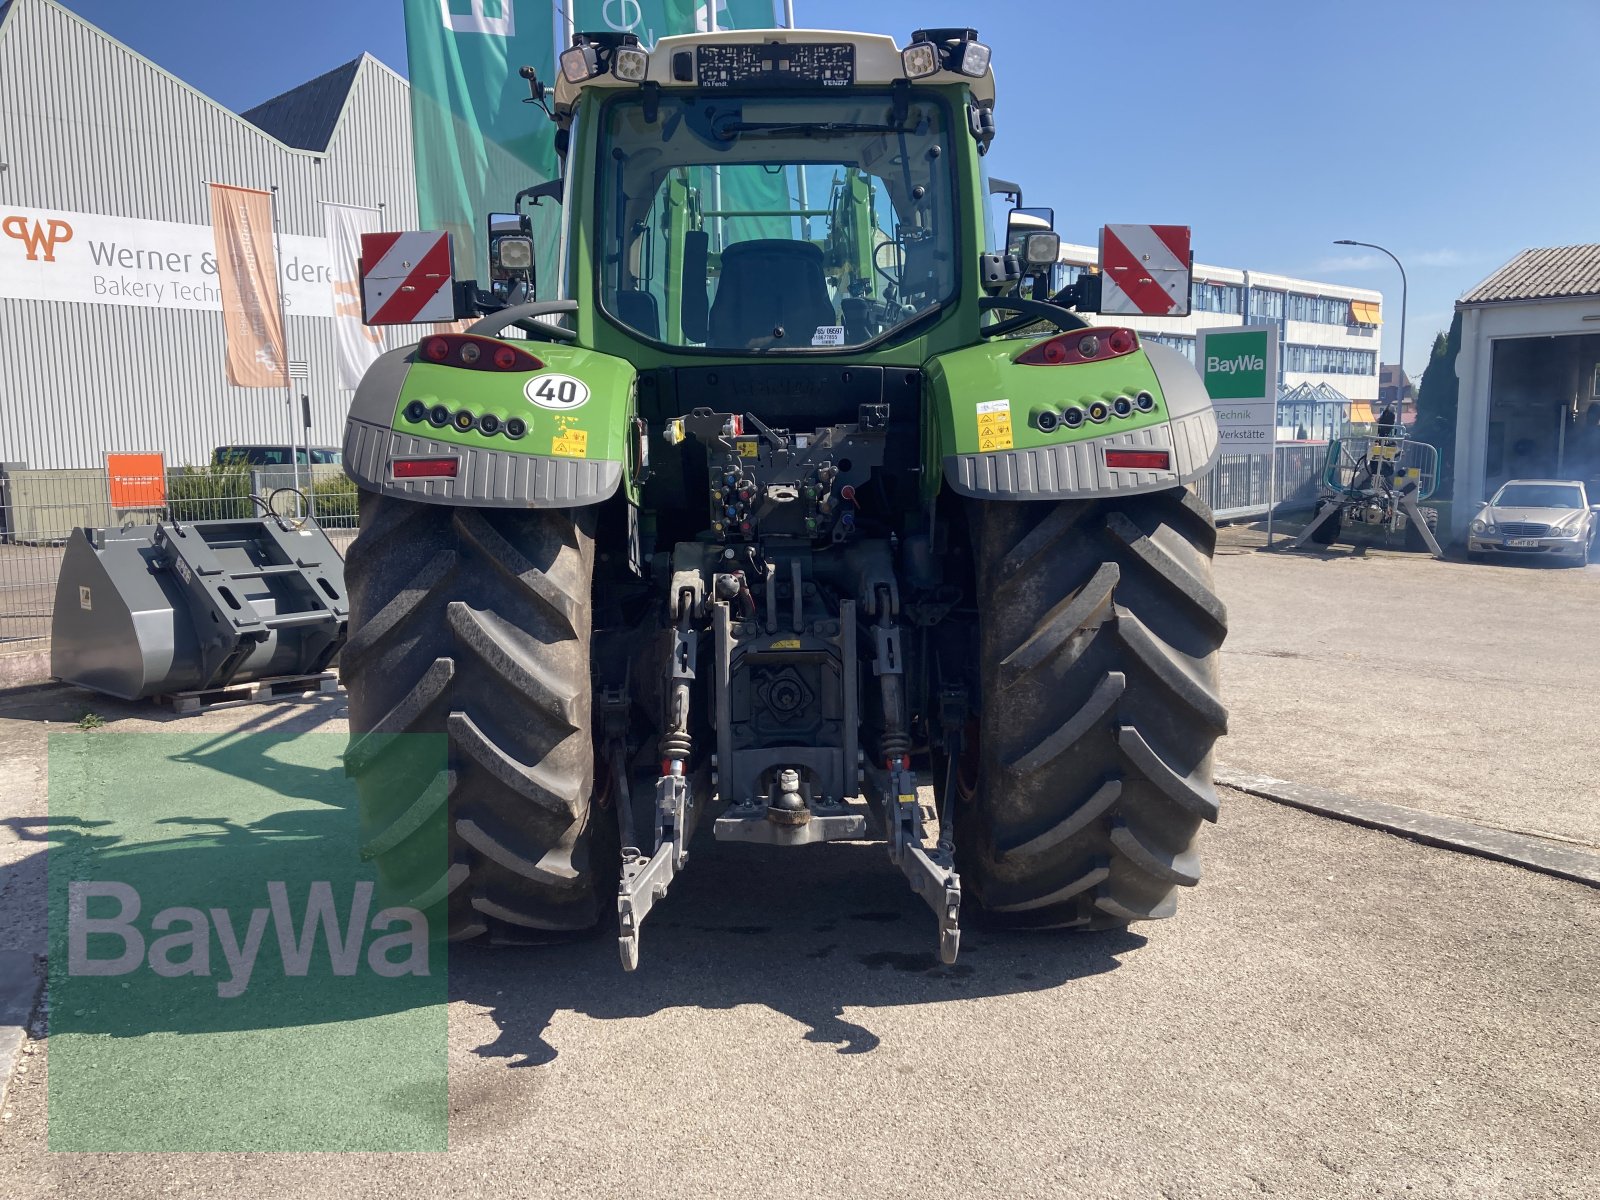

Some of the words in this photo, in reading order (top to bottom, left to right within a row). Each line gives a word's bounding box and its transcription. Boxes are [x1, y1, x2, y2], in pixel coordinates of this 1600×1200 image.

[88, 240, 192, 273] Werner
[200, 251, 220, 275] &
[93, 275, 164, 303] Bakery
[1207, 354, 1264, 375] BayWa
[536, 378, 577, 403] 40
[1216, 409, 1251, 420] Technik
